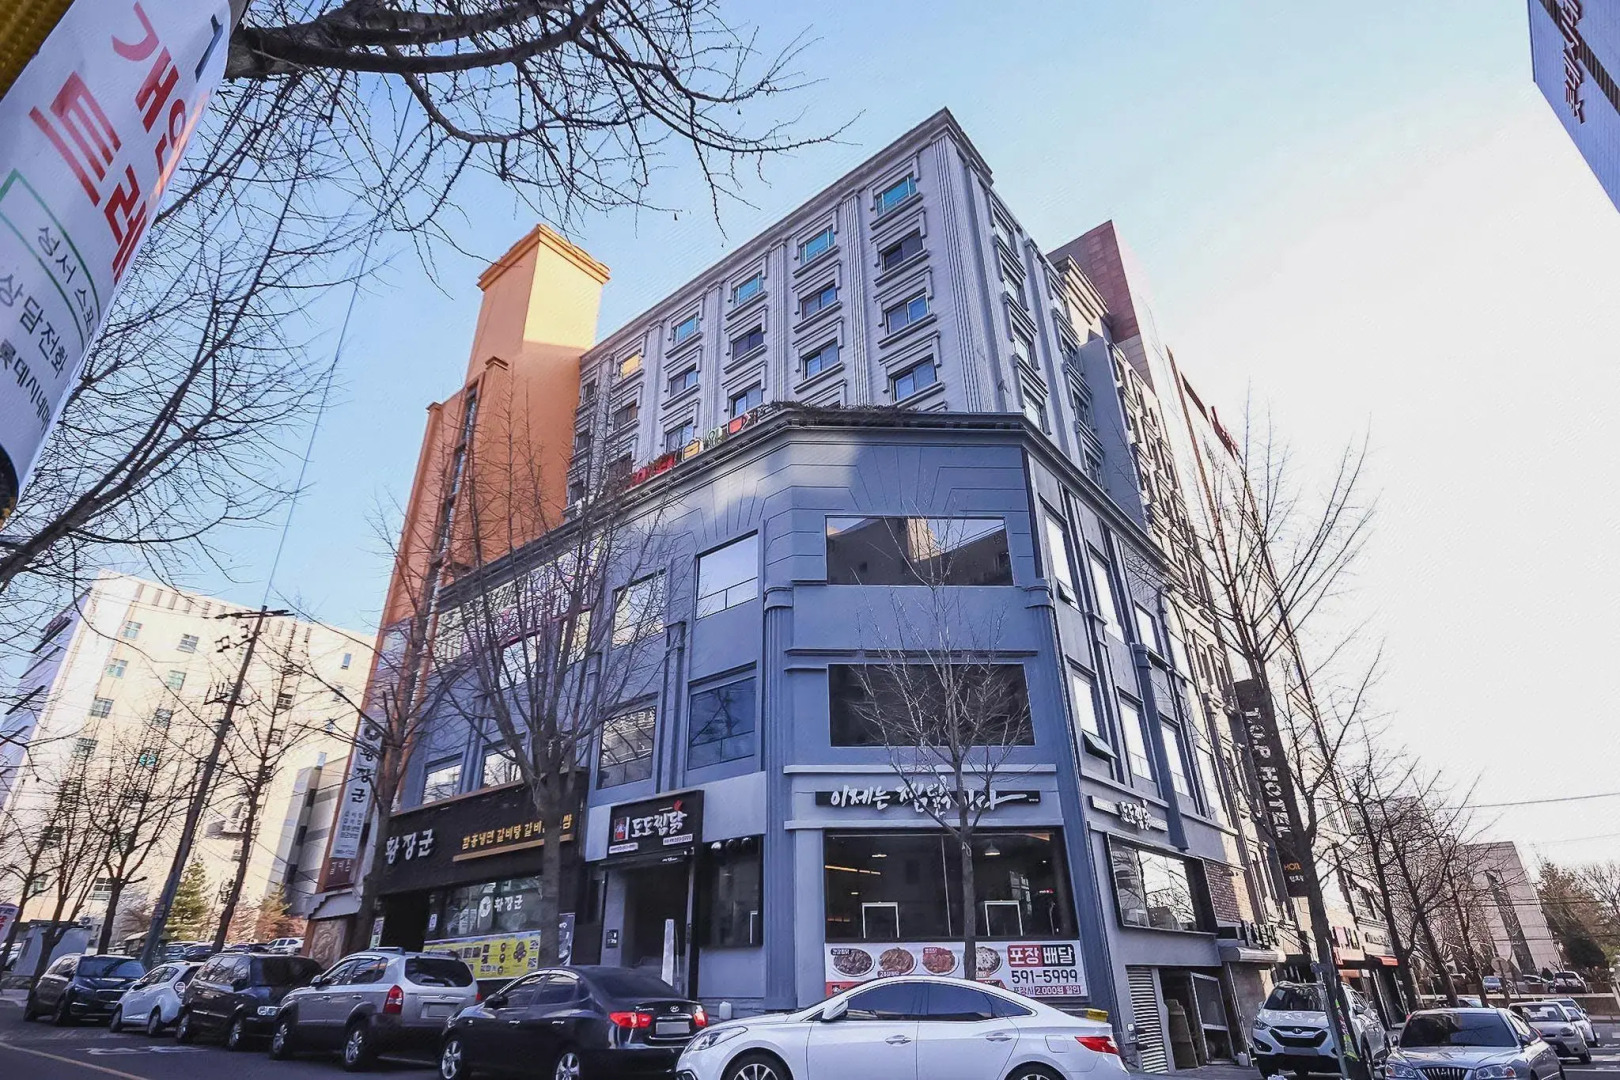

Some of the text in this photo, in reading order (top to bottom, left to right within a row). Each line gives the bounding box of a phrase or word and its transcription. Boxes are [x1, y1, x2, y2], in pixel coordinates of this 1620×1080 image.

[38, 227, 95, 341] 성서 스포
[0, 273, 69, 379] 상담전화
[830, 785, 891, 810] 이제는
[1260, 766, 1292, 838] HOTEL
[496, 824, 522, 843] 갈비탕
[524, 820, 546, 839] 갈비
[385, 829, 434, 865] 황장군
[494, 894, 524, 912] 황장군
[1010, 946, 1074, 964] 포장 배달
[1011, 969, 1078, 984] 591-5999
